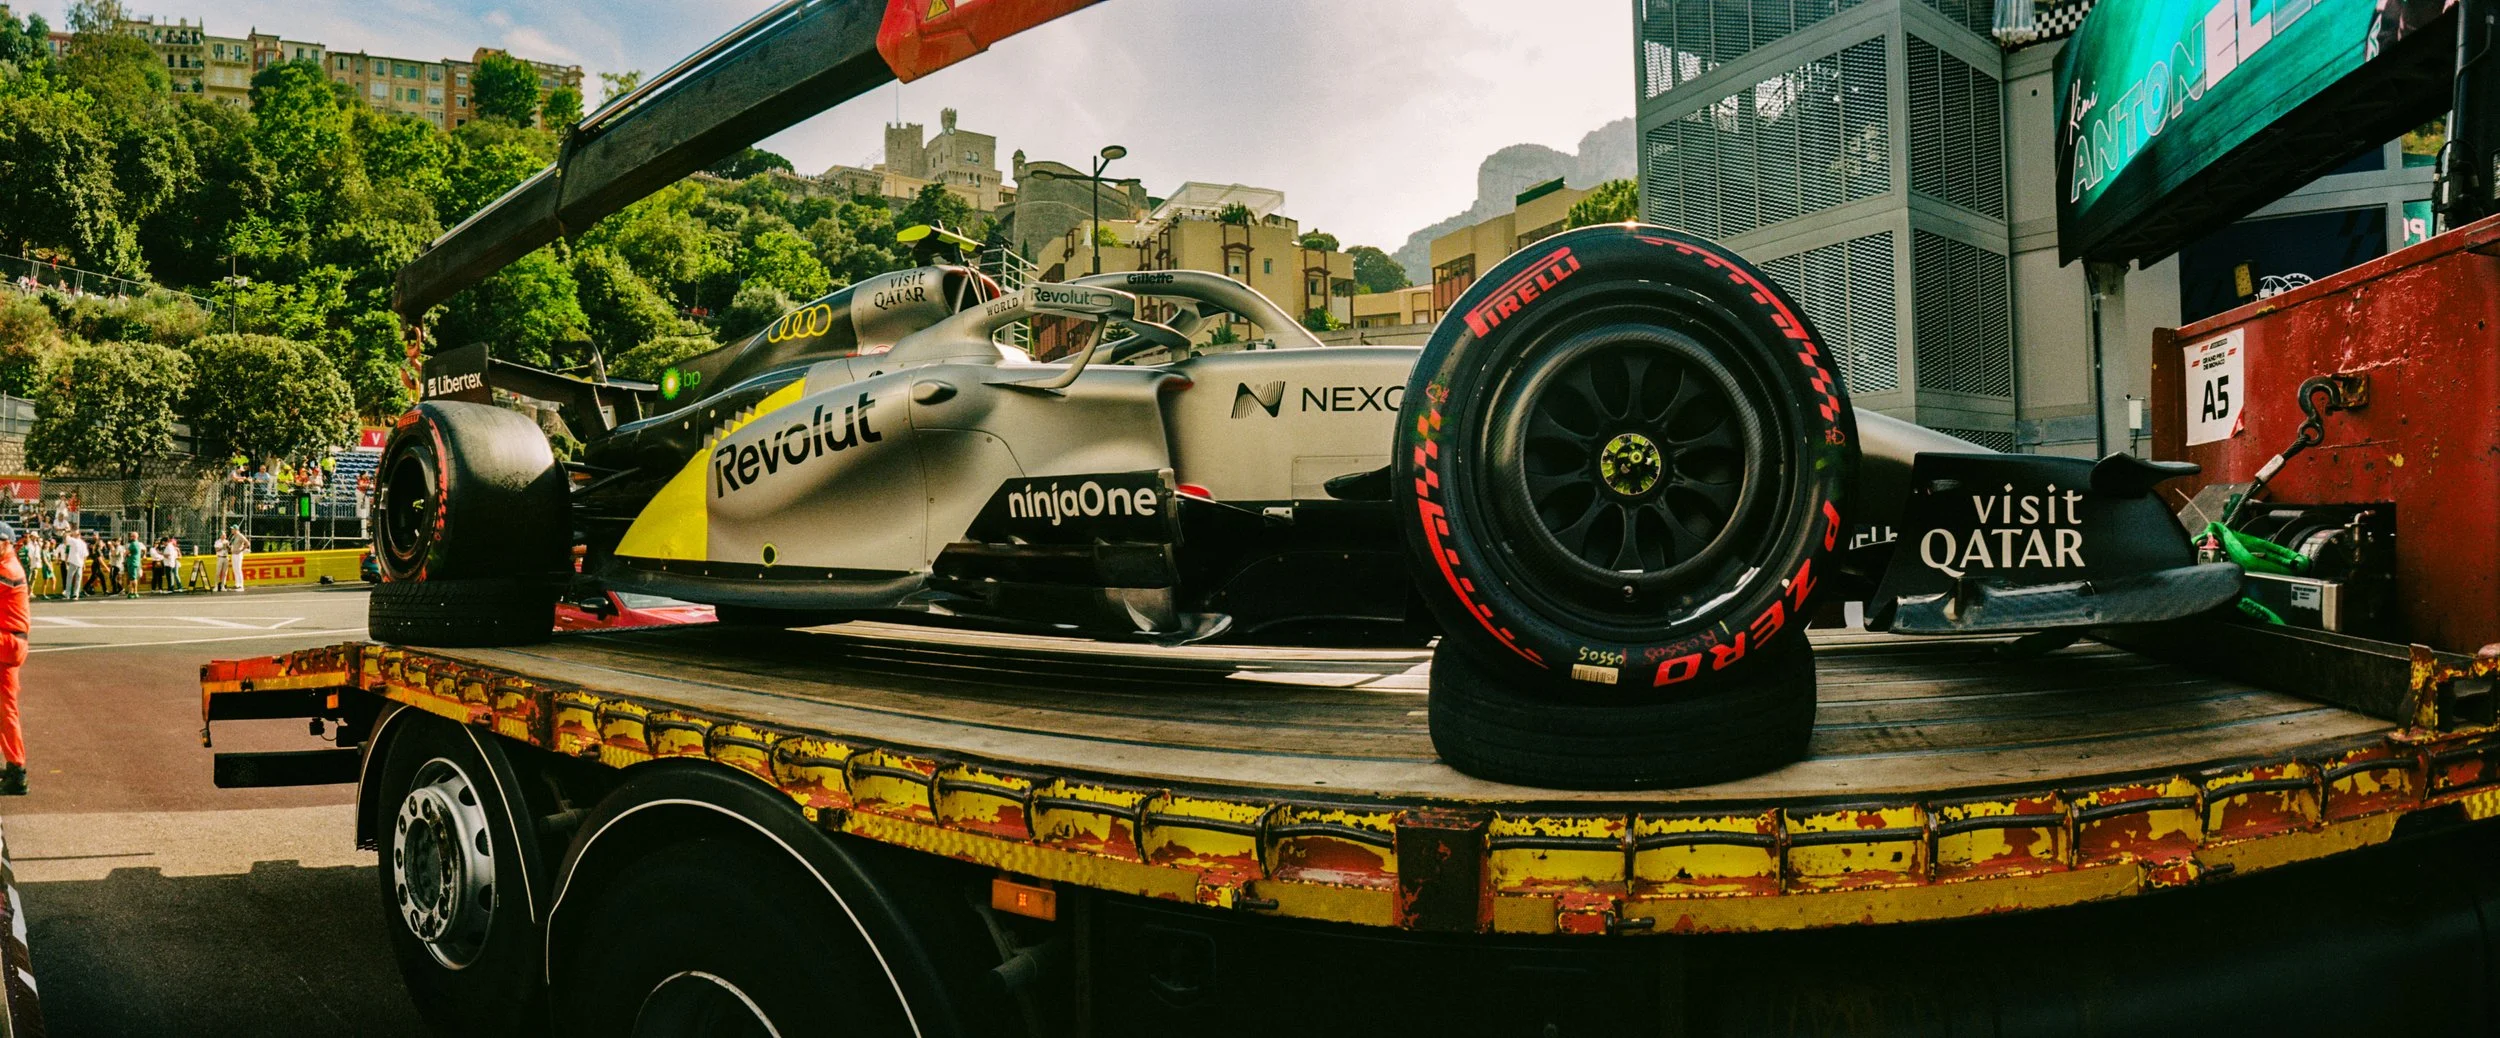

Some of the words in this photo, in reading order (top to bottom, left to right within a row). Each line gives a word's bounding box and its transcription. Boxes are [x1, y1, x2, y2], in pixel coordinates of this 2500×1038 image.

[2069, 78, 2099, 146] Kimi
[874, 286, 927, 311] QATAR
[890, 270, 926, 289] visit
[1031, 286, 1090, 305] Revolut
[1127, 272, 1174, 285] Gillette
[1463, 246, 1581, 338] PIRELLI
[986, 297, 1018, 316] WORLD
[438, 372, 484, 395] Libertex
[683, 369, 701, 390] bp
[2202, 375, 2229, 423] A5
[715, 392, 883, 498] Revolut
[1008, 481, 1158, 526] ninjaOne
[1972, 483, 2083, 524] visit
[1920, 528, 2086, 578] QATAR
[1653, 558, 1818, 687] ZERO
